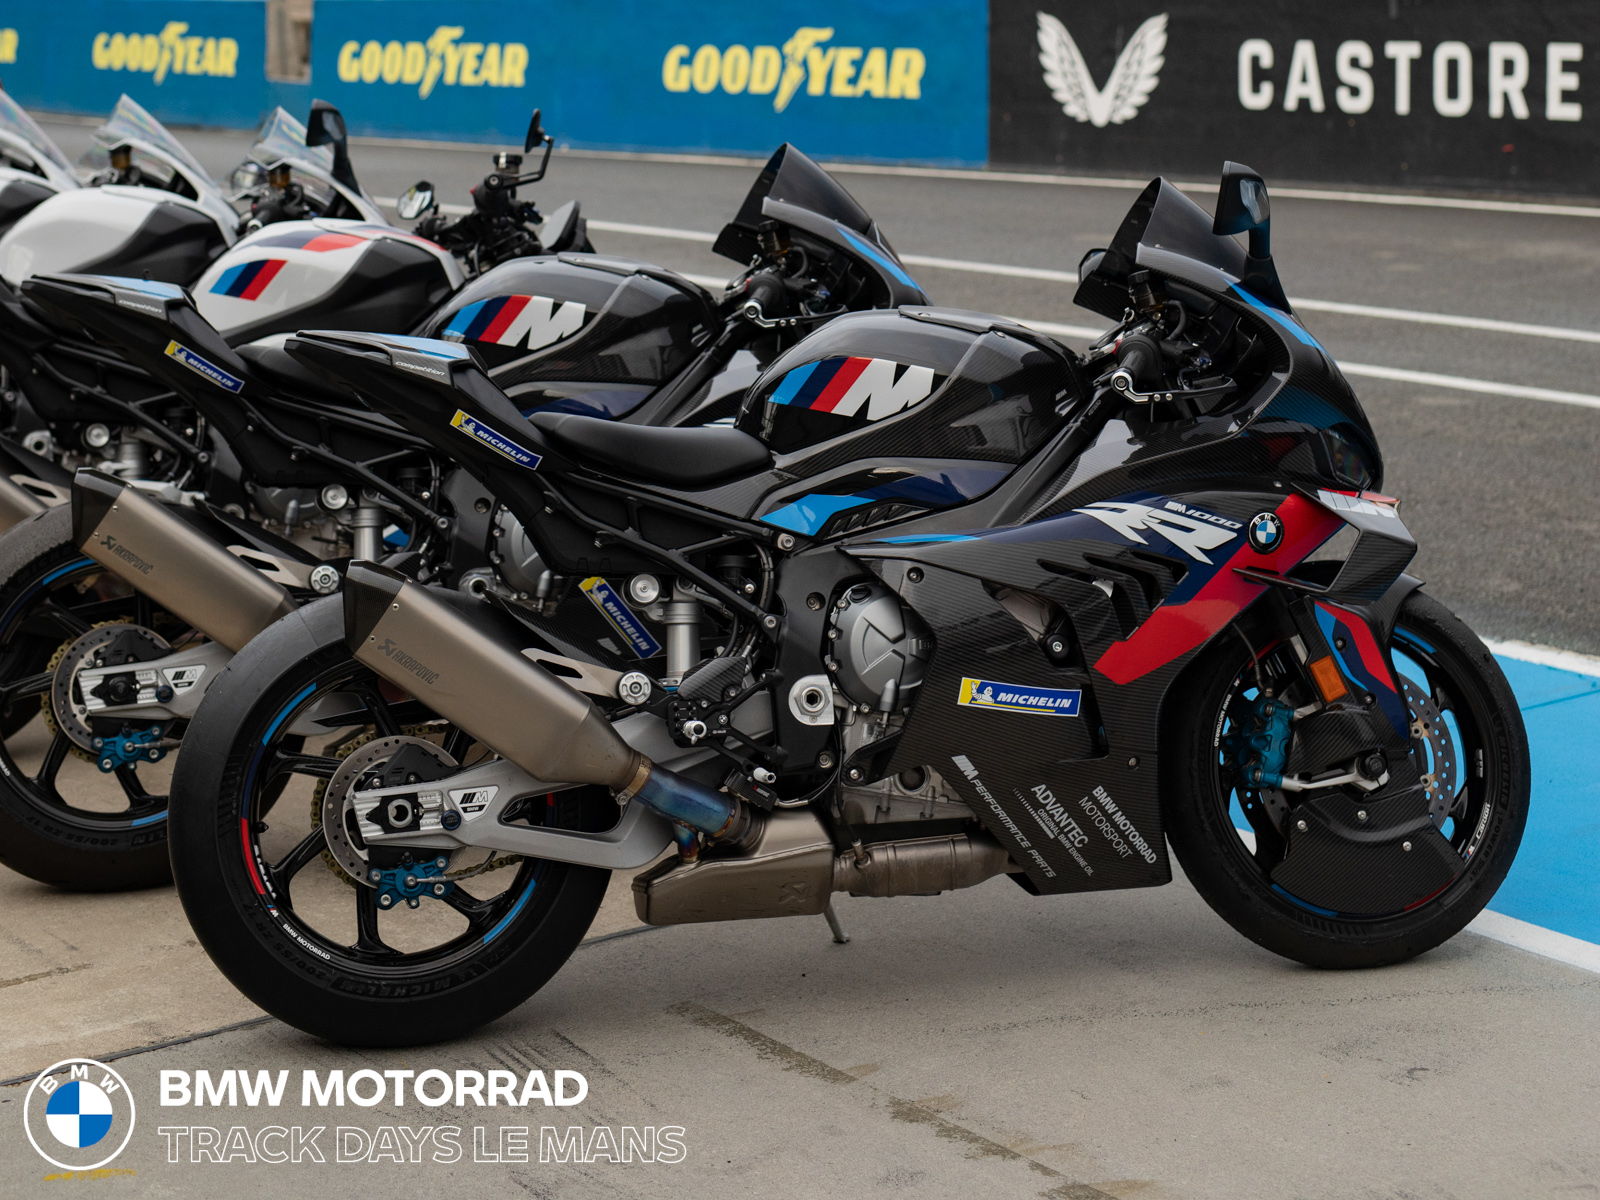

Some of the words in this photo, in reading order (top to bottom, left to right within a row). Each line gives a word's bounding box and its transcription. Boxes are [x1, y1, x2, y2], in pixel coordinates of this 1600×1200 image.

[92, 30, 239, 79] GOODYEAR
[337, 39, 529, 88] GOODYEAR
[662, 43, 926, 100] GOODYEAR
[1237, 38, 1584, 122] CASTORE
[187, 357, 235, 388] MICHELIN
[395, 360, 446, 377] competition
[476, 429, 531, 463] MICHELIN
[604, 601, 650, 651] MICHELIN
[997, 692, 1072, 708] MICHELIN
[1222, 693, 1232, 710] BMW
[1213, 710, 1226, 747] MOTORRAD
[1501, 737, 1510, 807] MICHELIN
[970, 779, 1032, 848] PERFORMANCE
[1027, 849, 1057, 878] PARTS
[1030, 784, 1089, 848] ADVANTEC
[1078, 796, 1133, 859] MOTORSPORT
[1092, 785, 1119, 814] BMW
[1112, 811, 1157, 864] MOTORRAD
[1483, 816, 1503, 859] POWER
[66, 833, 118, 846] 200/55
[1037, 808, 1060, 837] ORIGINAL
[1057, 834, 1073, 850] BMW
[1068, 847, 1088, 868] ENGINE
[1084, 861, 1094, 877] OIL
[254, 921, 273, 940] ZR
[283, 923, 298, 939] BMW
[296, 936, 331, 960] MOTORRAD
[272, 942, 327, 981] 200/55
[338, 976, 451, 998] MICHELIN
